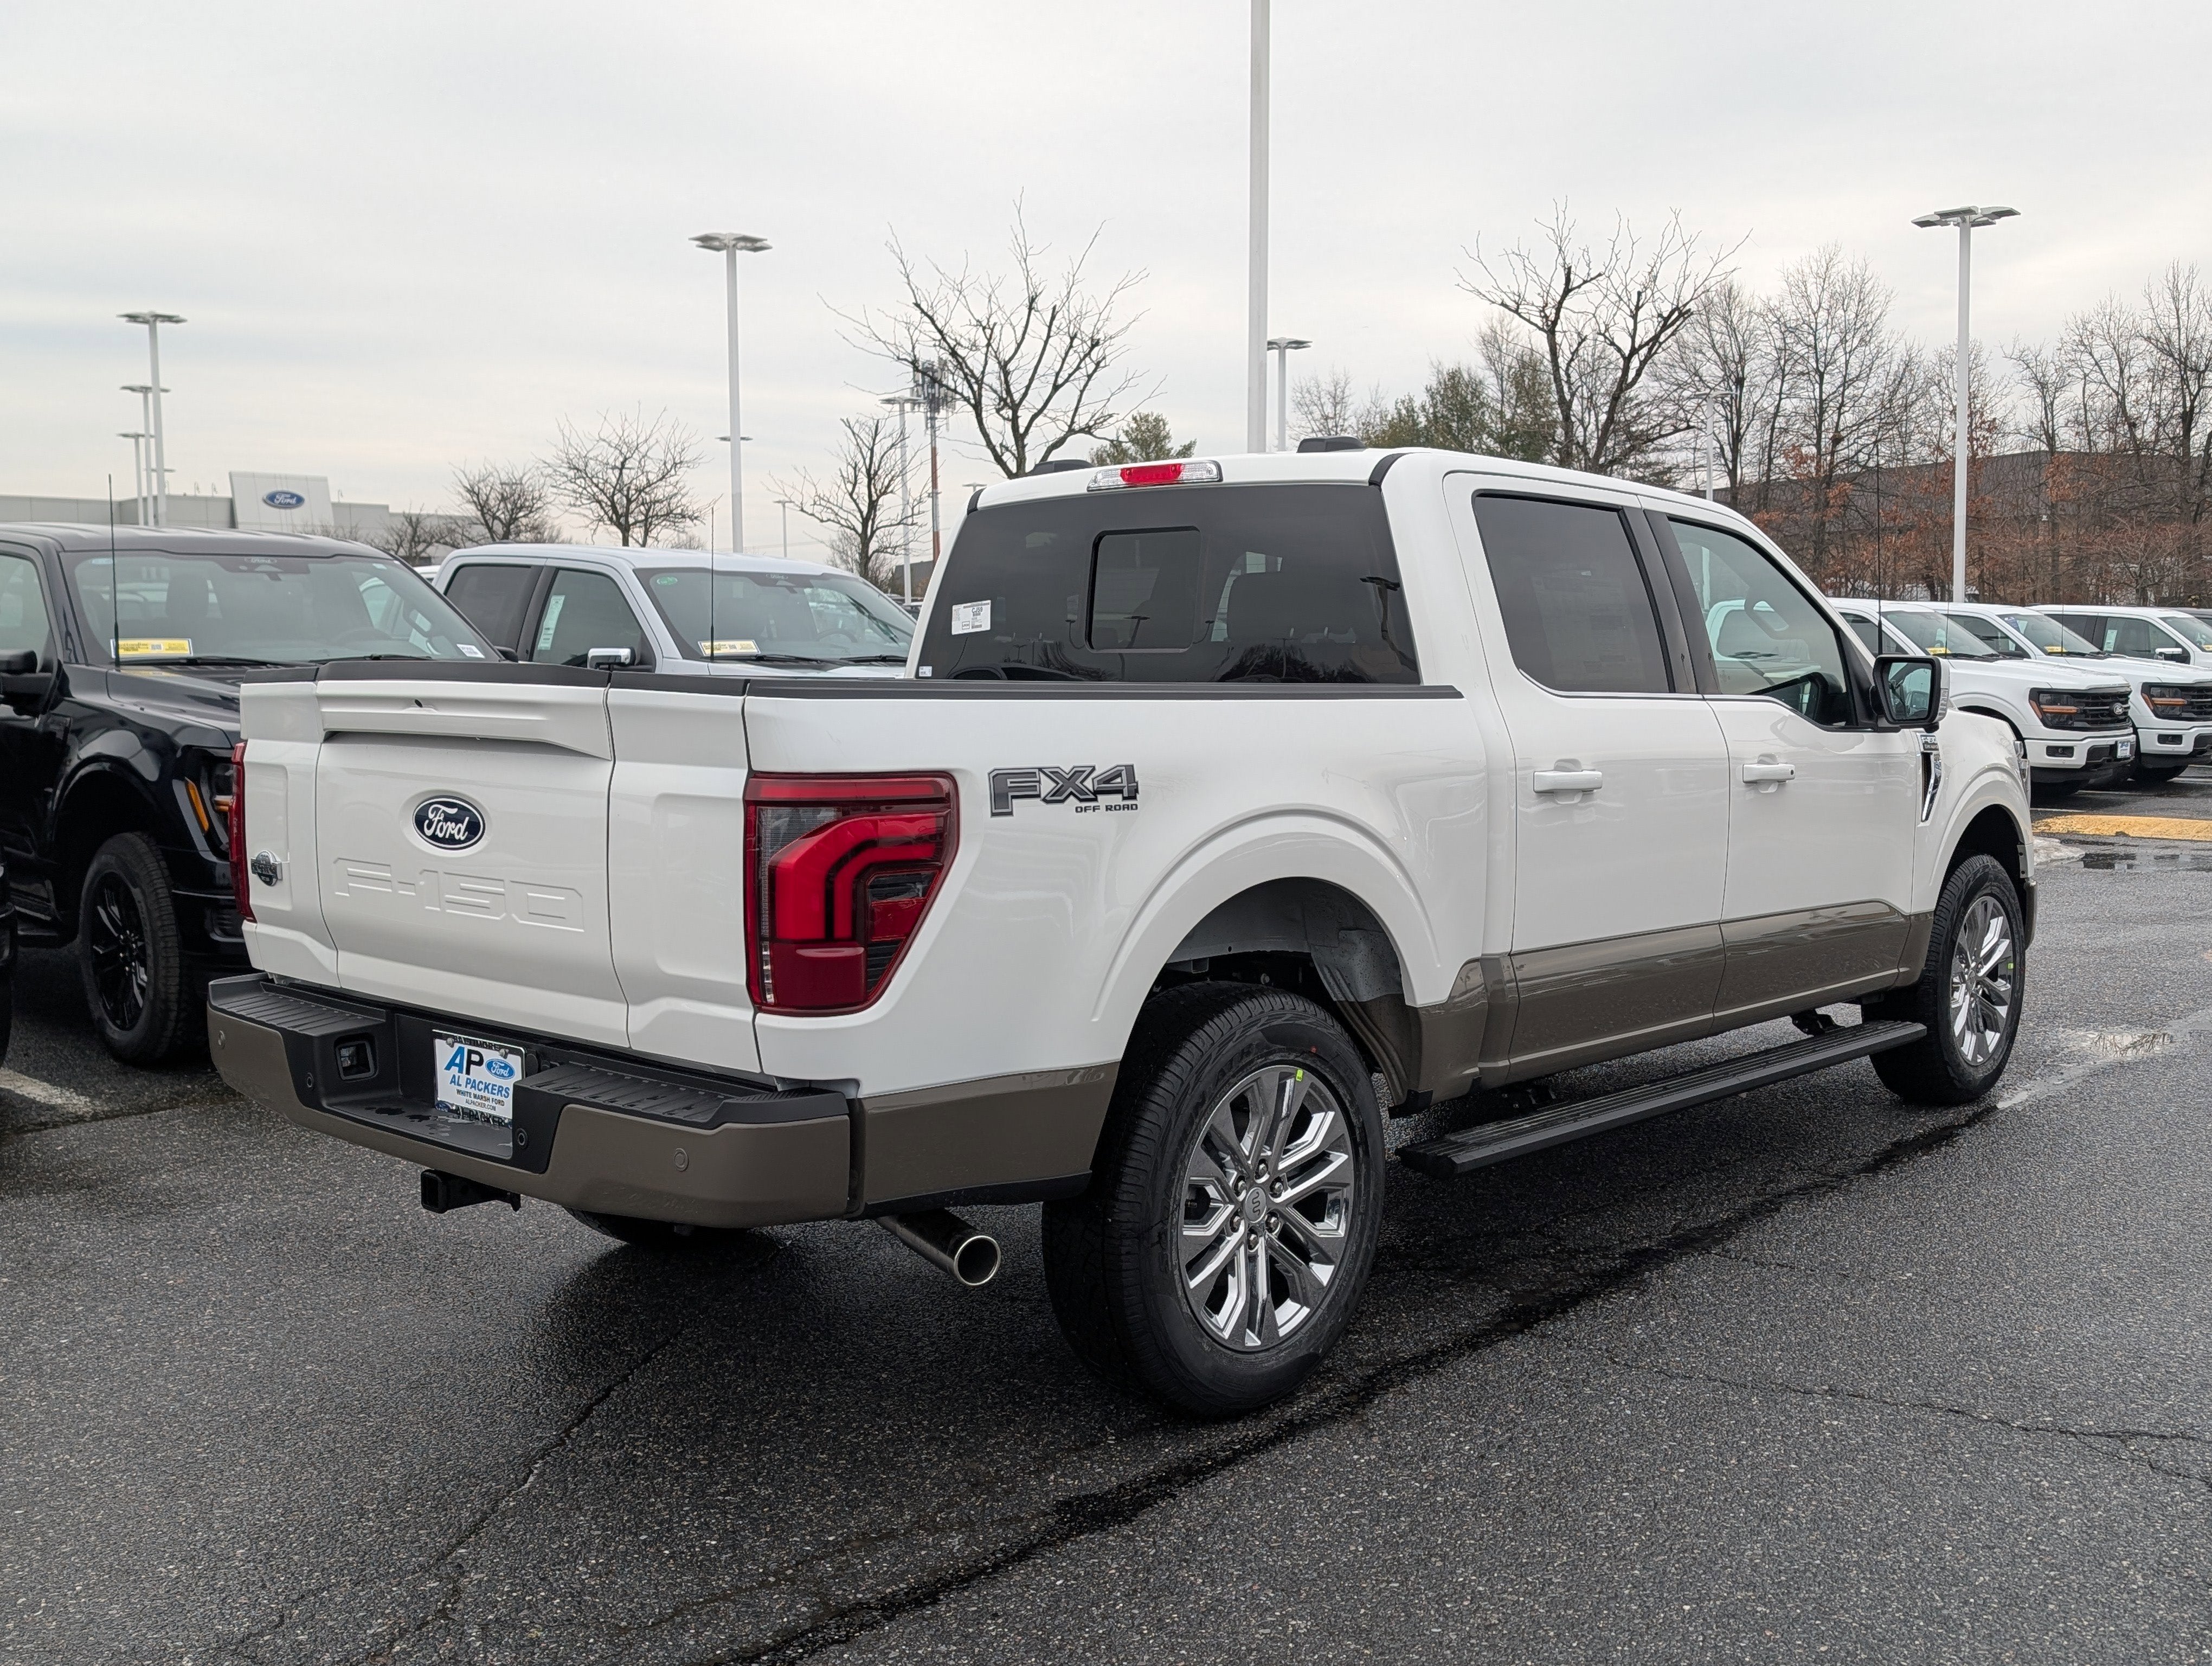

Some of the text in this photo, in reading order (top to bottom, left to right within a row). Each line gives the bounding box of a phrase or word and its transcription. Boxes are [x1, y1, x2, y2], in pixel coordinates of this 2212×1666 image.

[988, 764, 1139, 818] FX4
[1075, 804, 1139, 813] OFF ROAD
[423, 804, 470, 841] Ford
[333, 857, 584, 932] F-150
[443, 1046, 484, 1076] AP
[491, 1061, 510, 1076] Ford
[449, 1074, 510, 1099] AL PACKERS
[456, 1088, 505, 1106] WHITE MARSH FORD
